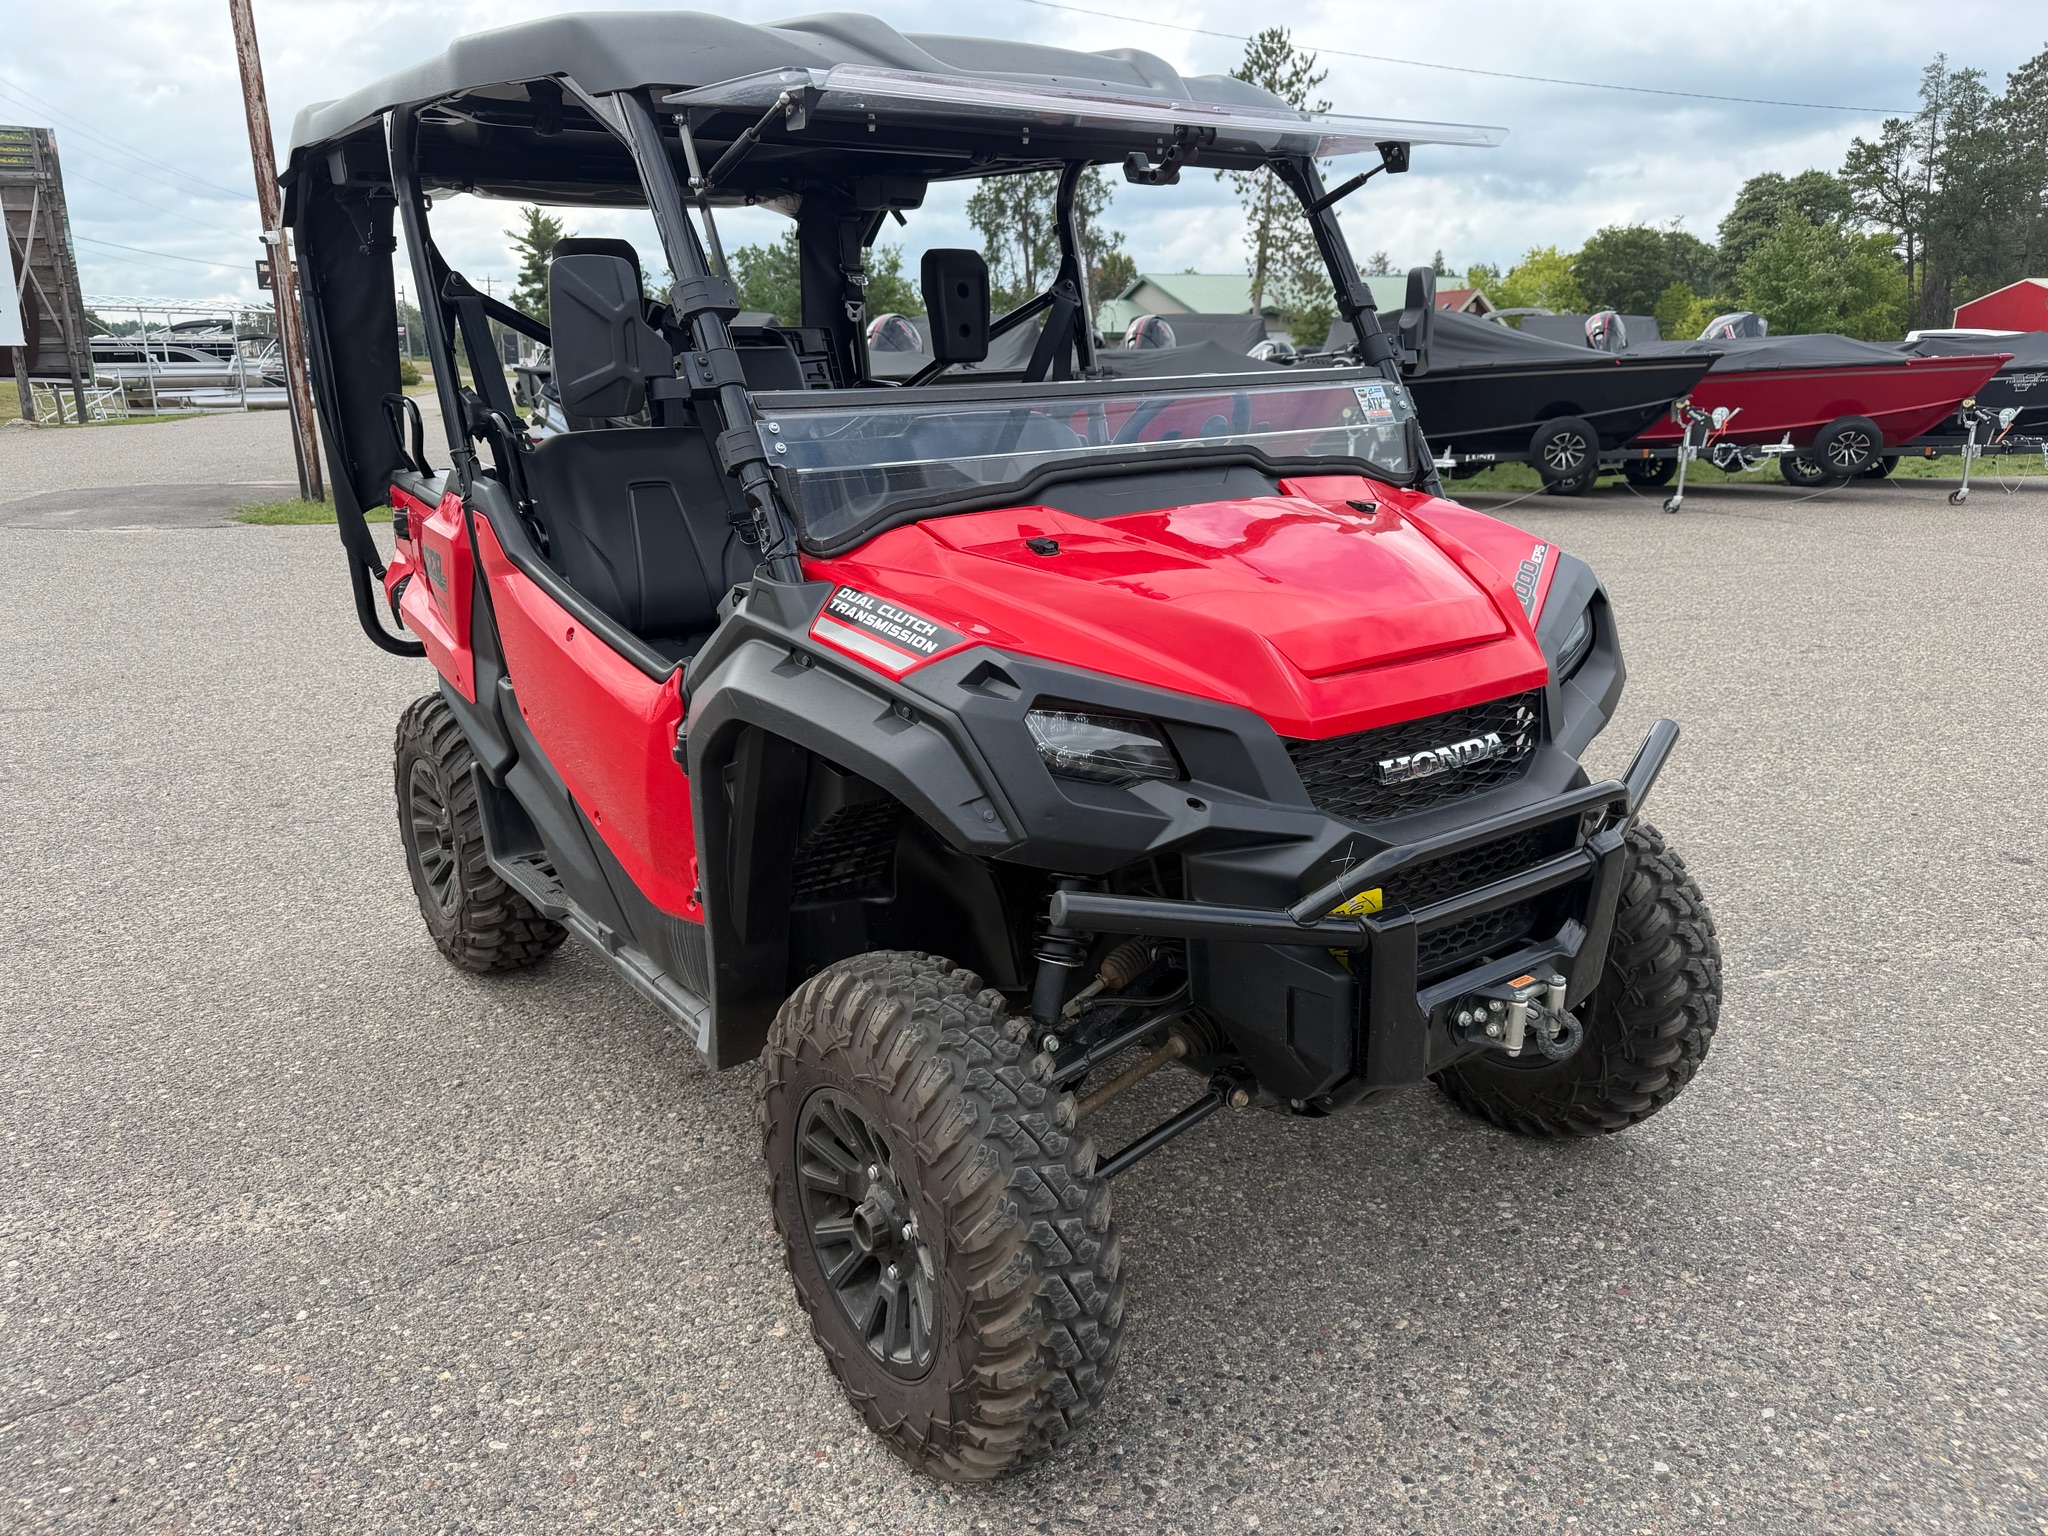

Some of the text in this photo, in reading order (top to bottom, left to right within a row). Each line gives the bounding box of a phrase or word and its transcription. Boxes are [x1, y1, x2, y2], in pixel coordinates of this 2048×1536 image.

[1367, 396, 1383, 410] ATV
[1465, 453, 1496, 462] LUND
[1531, 544, 1545, 564] EPS
[829, 598, 939, 654] TRANSMISSION
[837, 587, 938, 637] DUAL CLUTCH
[1378, 732, 1507, 786] HONDA
